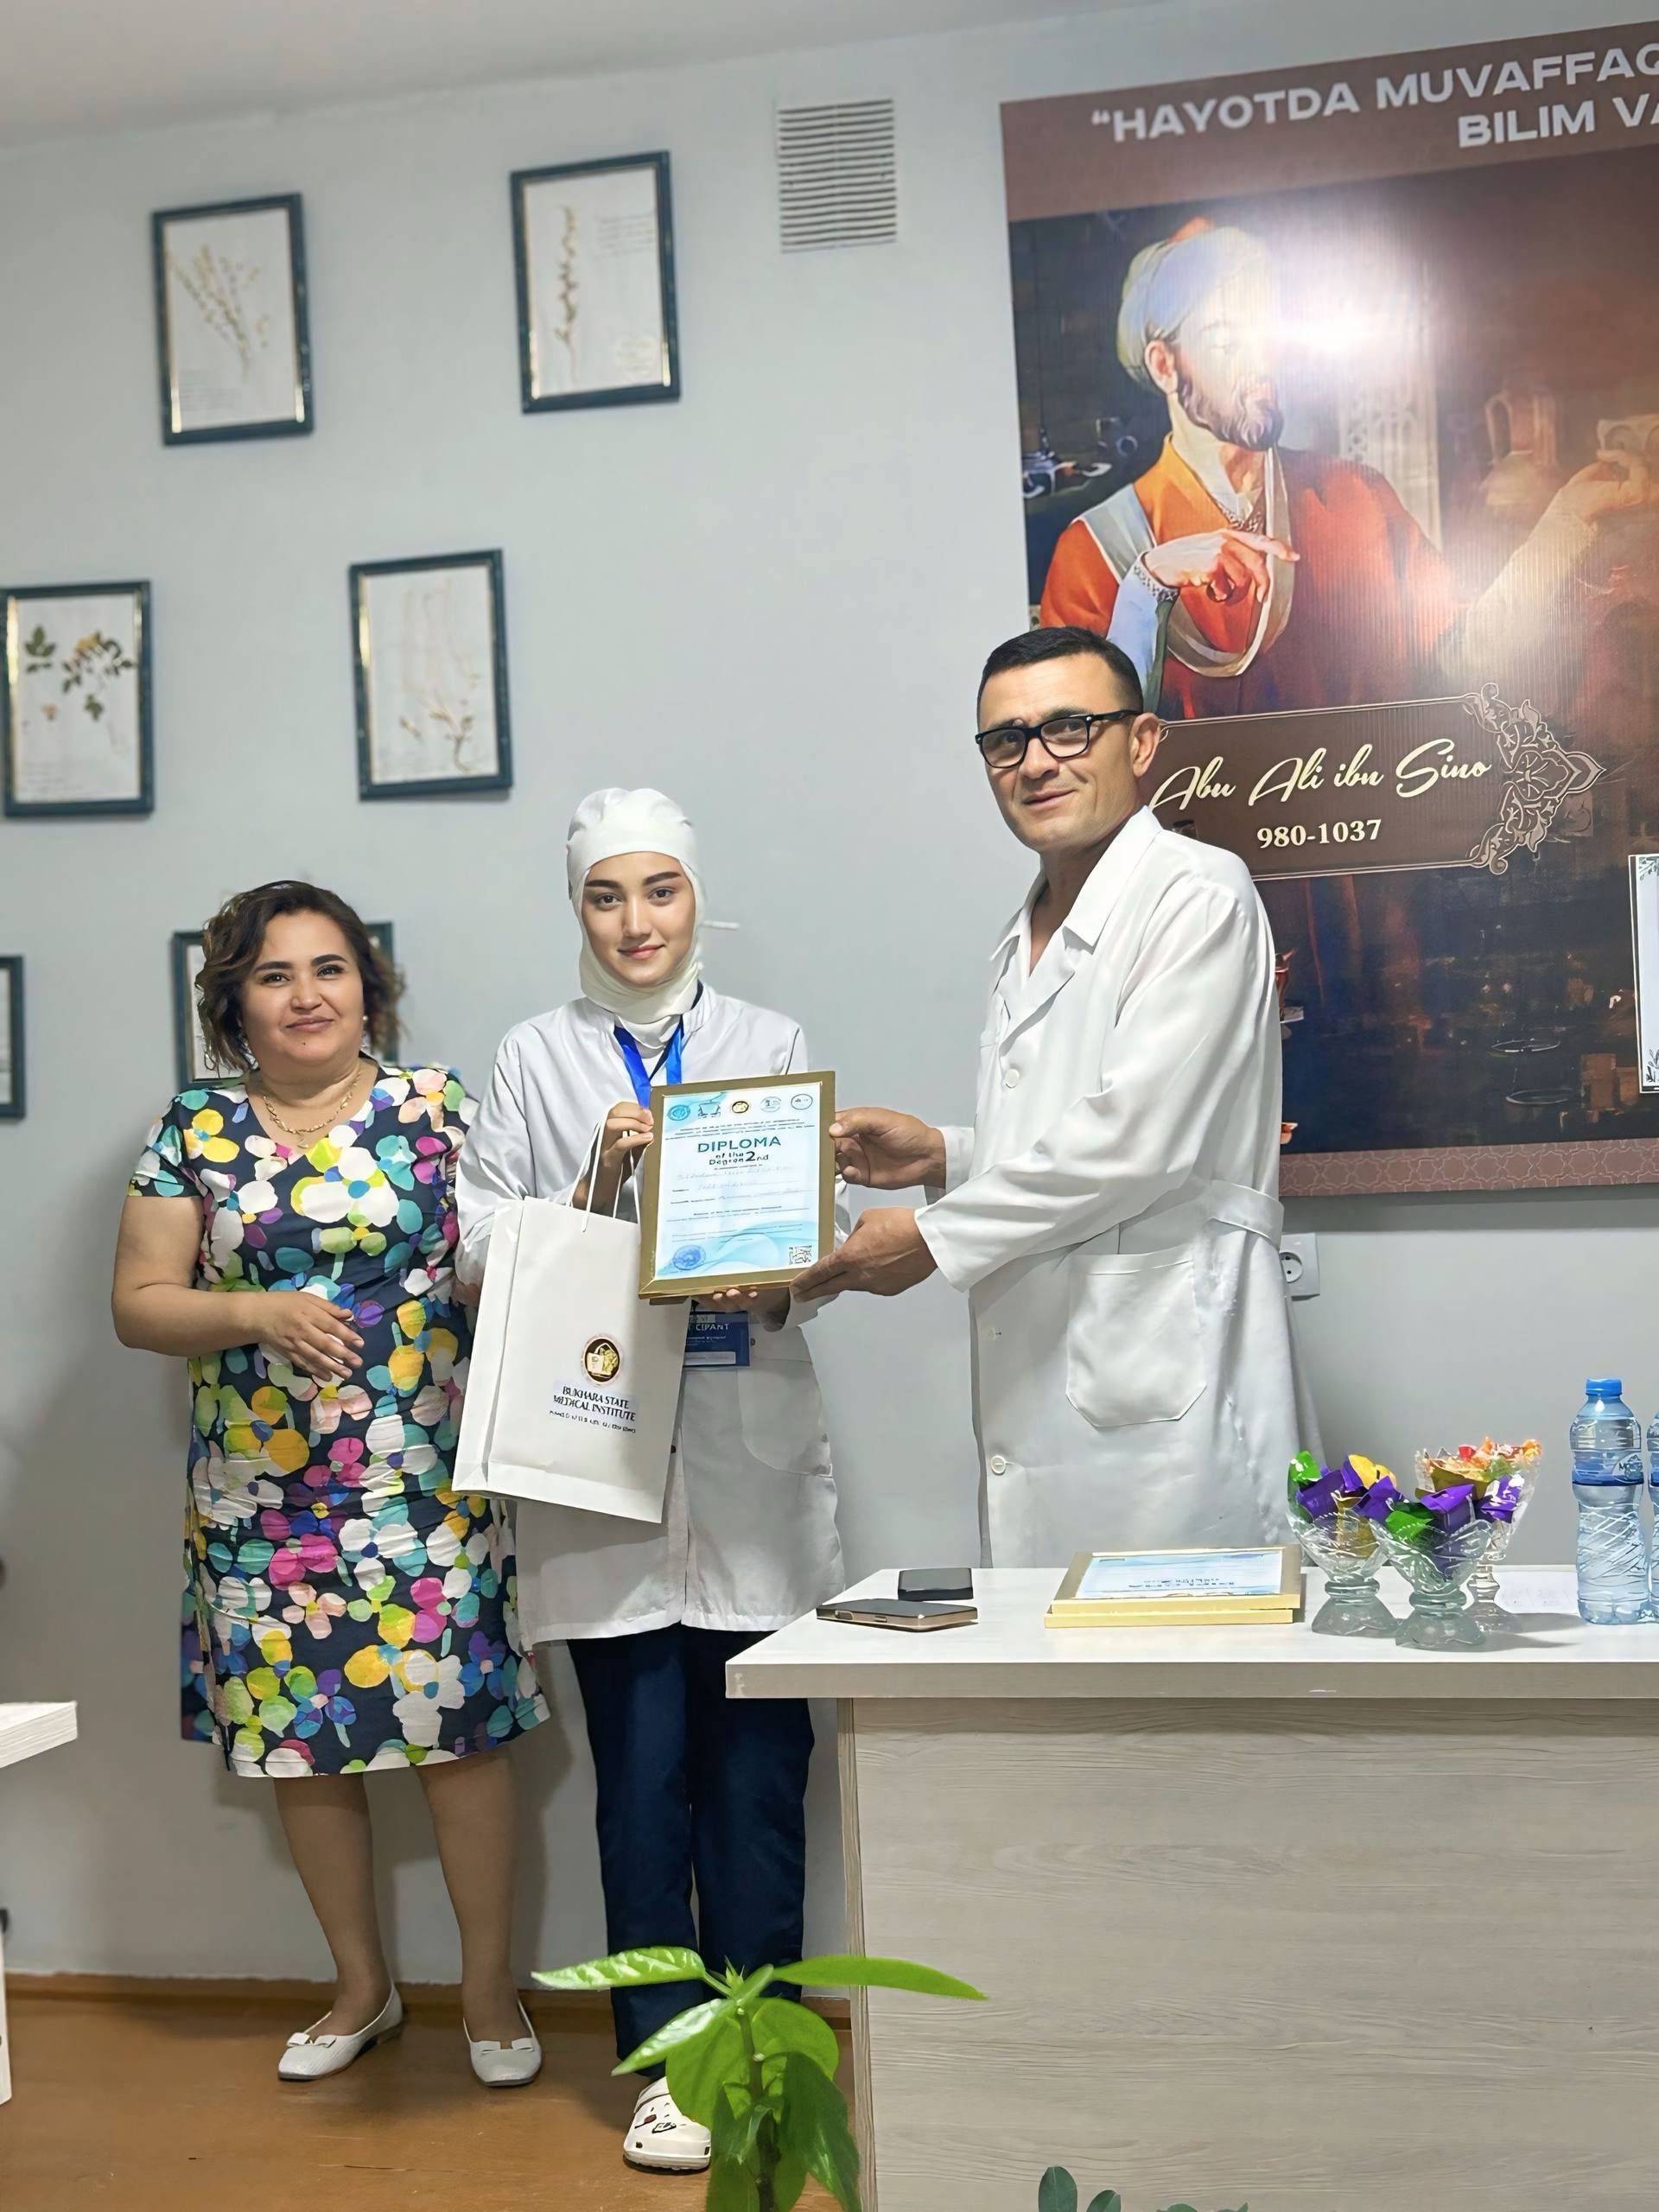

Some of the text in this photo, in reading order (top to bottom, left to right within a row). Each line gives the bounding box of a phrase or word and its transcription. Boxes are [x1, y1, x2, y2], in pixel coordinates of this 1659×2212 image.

[1458, 92, 1659, 148] BILIM V
[1152, 738, 1492, 811] Abu Ali ibn Sino
[1256, 819, 1382, 849] 980-1037
[697, 1136, 781, 1153] DIPLOMA
[689, 1323, 729, 1332] CIPANT
[553, 1395, 637, 1421] MEDICAL INSTITUTE
[563, 1386, 630, 1409] BUKHARA STATE
